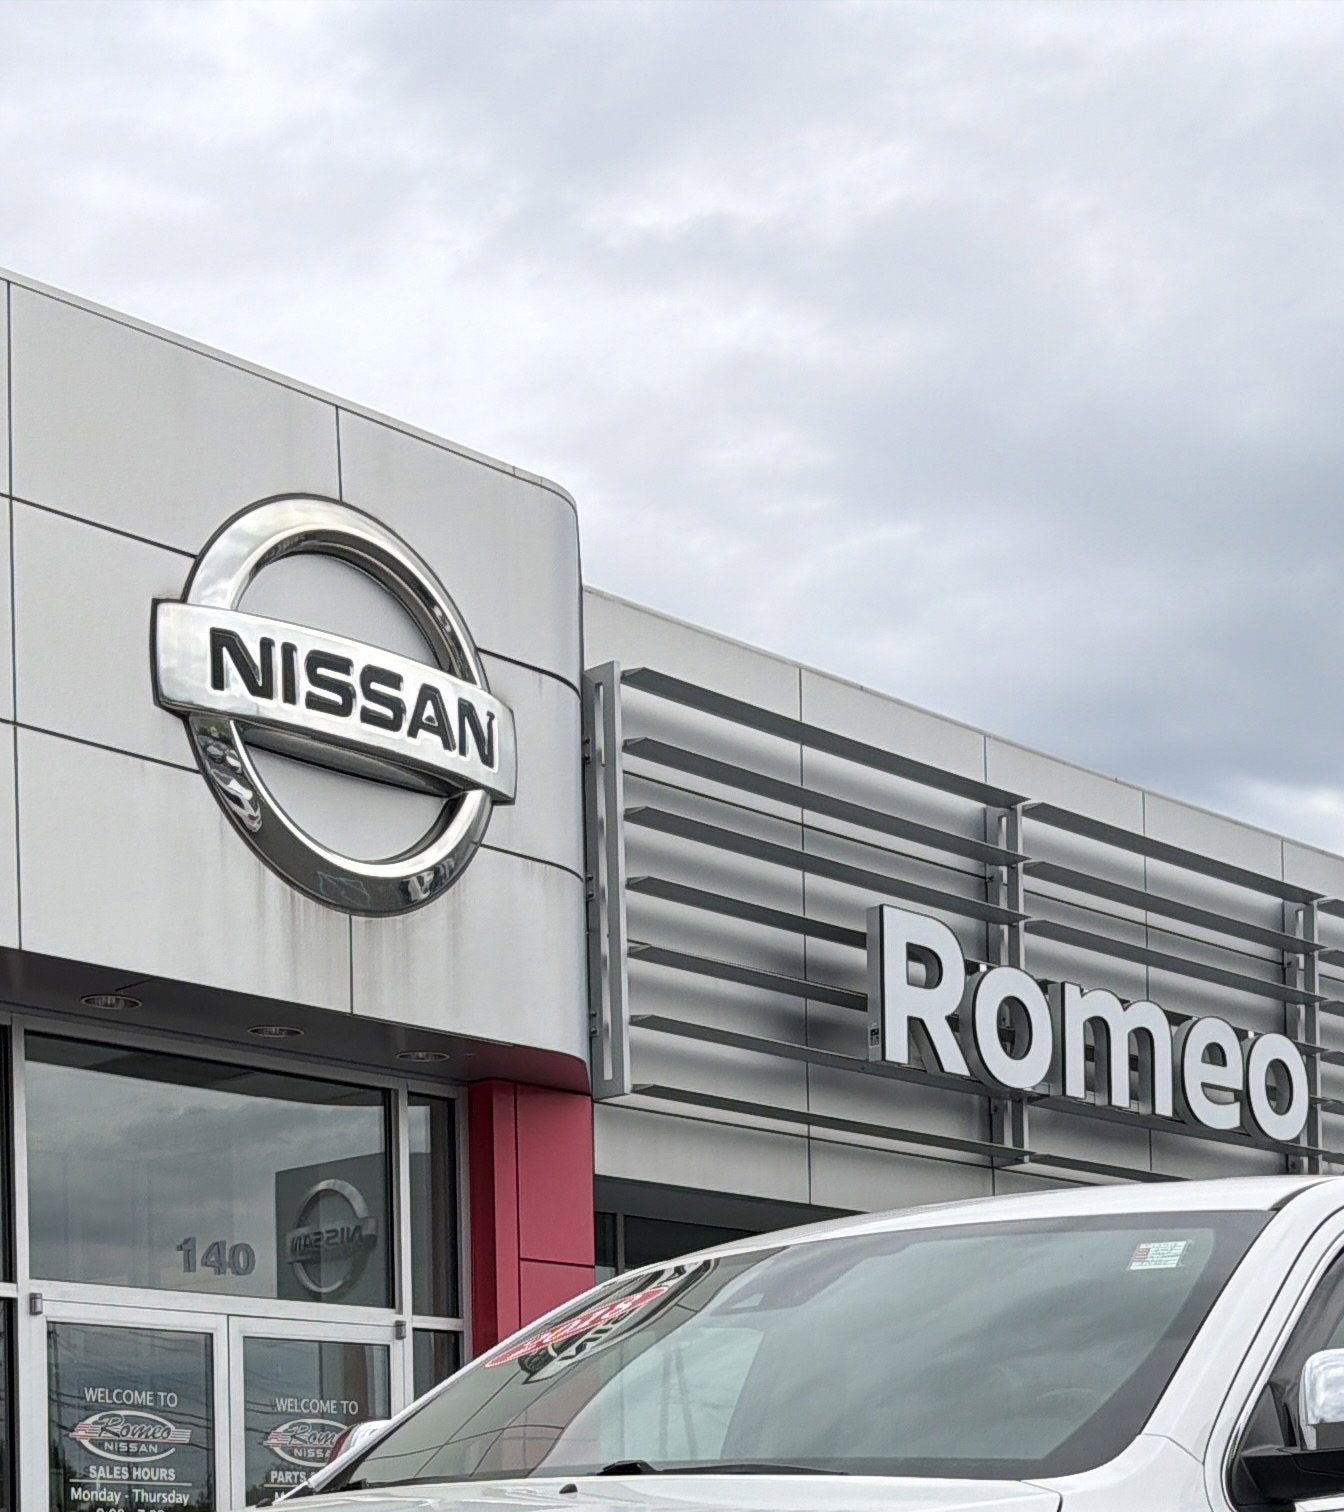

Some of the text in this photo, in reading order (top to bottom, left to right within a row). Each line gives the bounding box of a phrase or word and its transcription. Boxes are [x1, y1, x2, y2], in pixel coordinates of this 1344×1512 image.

[209, 626, 496, 769] NISSAN
[874, 902, 1310, 1142] Romeo
[175, 1236, 257, 1276] 140
[84, 1387, 178, 1408] WELCOME TO
[275, 1397, 359, 1415] WELCOME TO
[92, 1412, 173, 1440] Romeo
[283, 1421, 337, 1447] Rom
[104, 1441, 158, 1454] NISSAN
[293, 1448, 331, 1459] NISS
[88, 1465, 176, 1482] SALES HOURS
[270, 1470, 307, 1484] PARTS
[70, 1487, 122, 1505] Monday
[132, 1488, 190, 1507] Thursday
